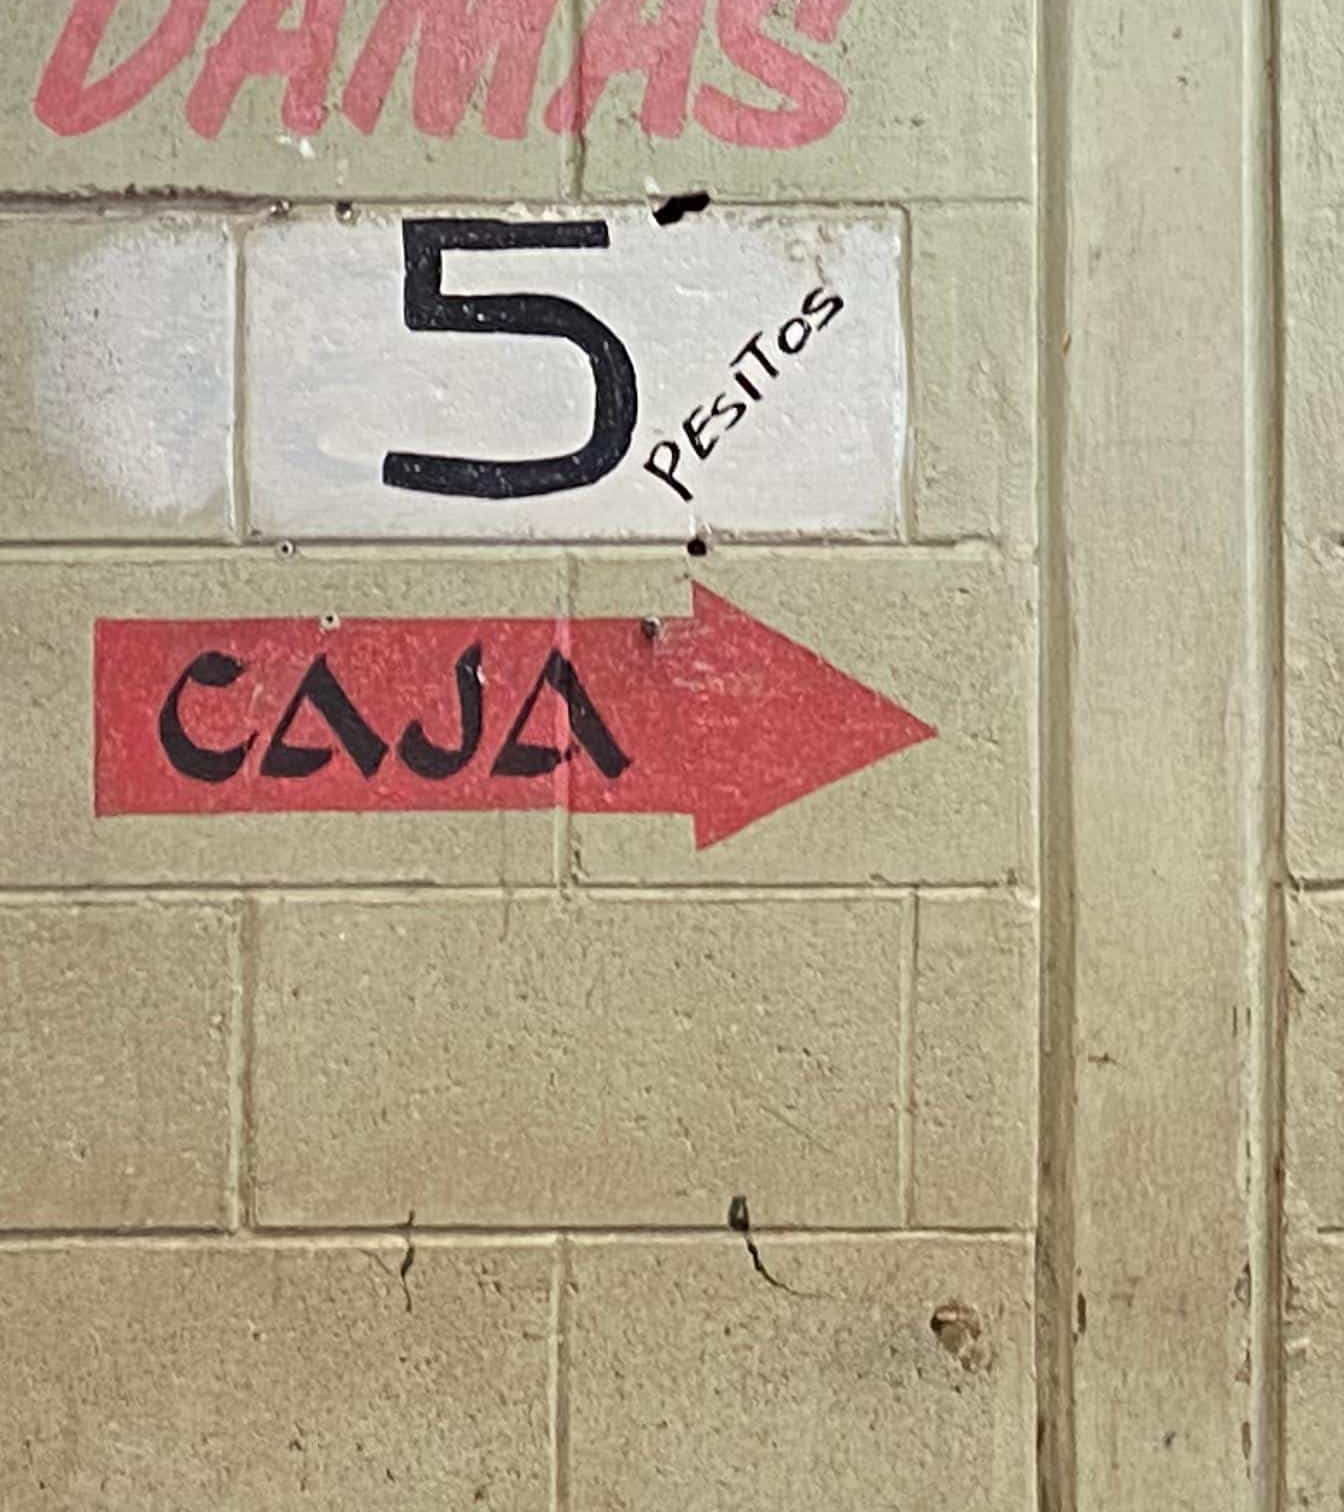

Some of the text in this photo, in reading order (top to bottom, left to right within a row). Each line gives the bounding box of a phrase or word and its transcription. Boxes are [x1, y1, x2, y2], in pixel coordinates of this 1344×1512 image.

[381, 218, 845, 503] 5 PESITOS
[157, 640, 631, 783] CAJA
